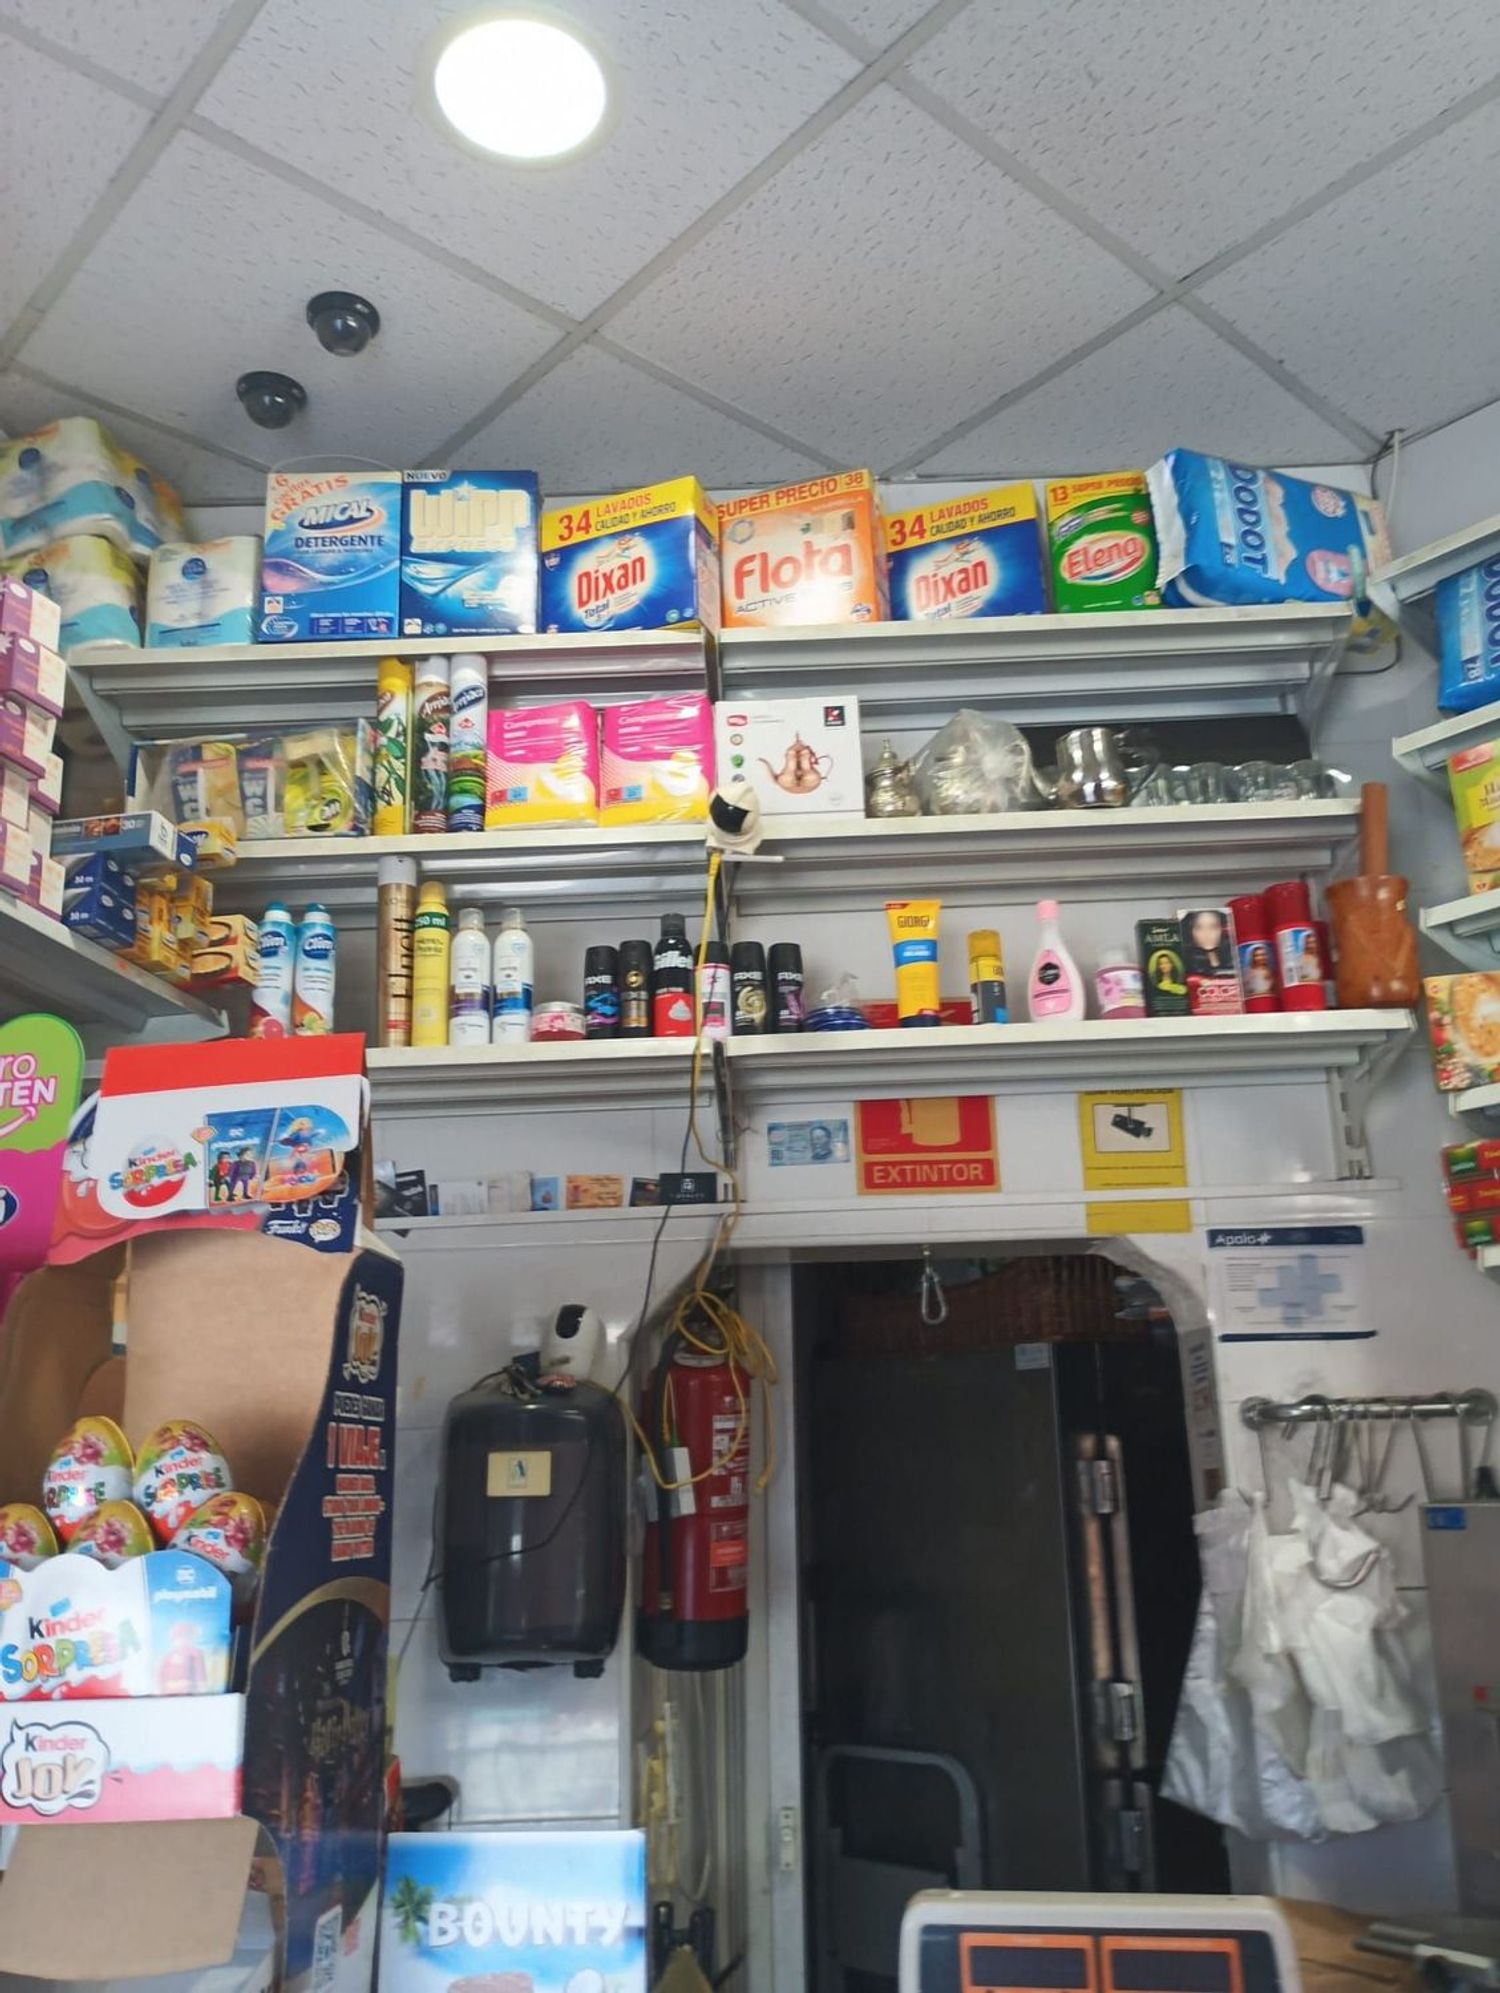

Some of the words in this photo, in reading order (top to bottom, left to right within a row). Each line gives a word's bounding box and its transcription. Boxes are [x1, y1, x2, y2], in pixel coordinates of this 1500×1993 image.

[406, 471, 447, 480] NUEVO
[271, 474, 348, 521] GRATIS
[718, 494, 769, 520] SUPER
[775, 479, 837, 505] PRECIO
[844, 472, 864, 486] 38
[558, 510, 592, 541] 34
[595, 492, 652, 517] LAVADOS
[595, 512, 630, 531] CALIDAD
[638, 501, 676, 520] AHORRO
[889, 514, 926, 547] 34
[930, 498, 988, 523] LAVADOS
[930, 518, 966, 536] CALIDAD
[977, 506, 1016, 525] AHORRO
[1228, 461, 1269, 575] DODOT
[295, 535, 384, 548] DETERGENTE
[577, 556, 645, 610] Dixan
[734, 540, 853, 600] Flota
[914, 560, 988, 612] Dixan
[733, 971, 763, 980] AXE
[109, 1151, 197, 1190] SORPRESA
[128, 1149, 178, 1168] Kinder
[872, 1162, 985, 1184] EXTINTOR
[48, 1470, 86, 1483] inder
[154, 1457, 203, 1478] Kinder
[28, 1608, 107, 1640] Kinder
[1, 1618, 141, 1683] SORPRESA
[25, 1733, 85, 1753] Kinder
[14, 1753, 97, 1800] JOY
[428, 1901, 628, 1948] BOUNTY
